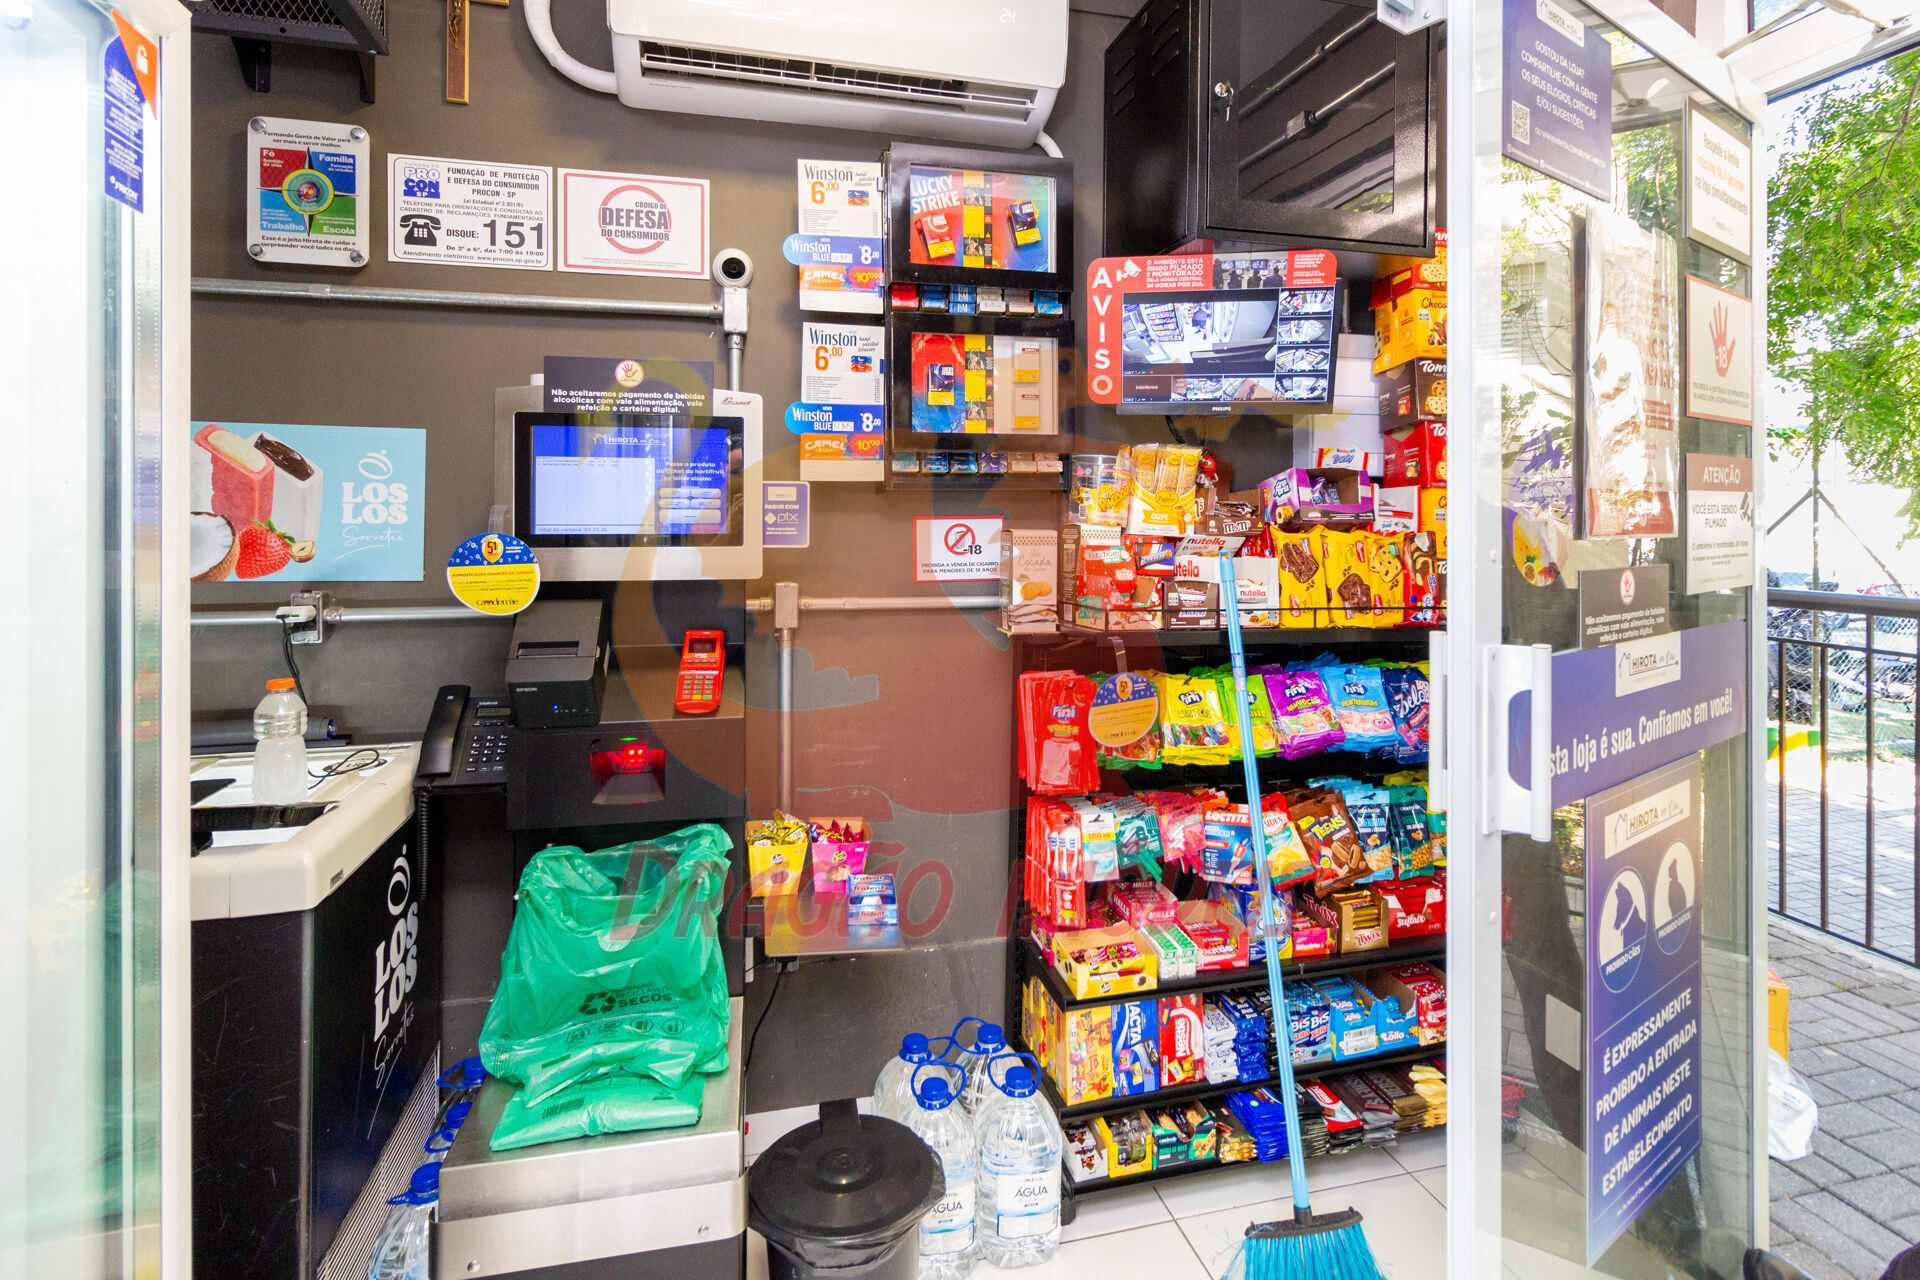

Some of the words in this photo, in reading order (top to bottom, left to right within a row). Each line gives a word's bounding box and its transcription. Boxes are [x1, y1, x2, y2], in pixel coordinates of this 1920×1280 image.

[1000, 8, 1016, 23] 24
[1535, 40, 1560, 64] GOSTOU
[1568, 60, 1585, 78] LOJA?
[1521, 50, 1562, 83] COMPARTILHE
[1562, 74, 1575, 90] COM
[1522, 69, 1531, 83] OS
[1531, 74, 1547, 92] SEUS
[262, 149, 276, 157] Fé
[319, 154, 354, 164] Família
[404, 166, 440, 180] PRO
[447, 167, 486, 178] FUNDAÇÃO
[489, 170, 500, 178] DE
[503, 171, 540, 182] PROTEÇÃO
[804, 164, 853, 182] Winston
[404, 178, 440, 192] CON
[453, 177, 480, 186] DEFESA
[494, 180, 540, 190] CONSUMIDOR
[910, 174, 953, 197] LUCKY
[472, 188, 500, 198] PROCON
[506, 190, 516, 198] SP
[403, 200, 434, 208] TELEFONE
[452, 204, 494, 212] ORIENTAÇÕES
[500, 206, 534, 215] CONSULTAS
[635, 201, 658, 210] CÓDIGO
[912, 191, 960, 214] STRIKE
[400, 206, 433, 214] CADASTRO
[446, 209, 491, 218] RECLAMAÇÕES
[494, 213, 544, 222] FUNDAMENTADAS
[602, 207, 669, 230] DEFESA
[262, 222, 304, 231] Trabalho
[323, 226, 354, 235] Escola
[446, 228, 480, 239] DISQUE:
[483, 219, 544, 250] 151
[601, 228, 612, 238] DO
[614, 229, 670, 241] CONSUMIDOR
[790, 238, 831, 253] Winston
[403, 250, 442, 258] Atendimento
[812, 252, 831, 262] BLUE
[1146, 264, 1168, 272] SENDO
[804, 270, 846, 282] CAMEL
[809, 327, 857, 347] Winston
[1092, 266, 1113, 396] AVISO
[554, 396, 597, 404] alcoólicas
[634, 398, 685, 408] alimentação,
[569, 390, 617, 398] aceitaremos
[618, 392, 662, 400] pagamento
[675, 392, 705, 400] bebidas
[577, 404, 610, 412] refeição
[792, 406, 832, 422] Winston
[814, 421, 832, 431] BLUE
[608, 436, 638, 444] HIROTA
[804, 440, 846, 450] CAMEL
[690, 461, 716, 469] produto
[1703, 464, 1741, 487] ATENÇÃO
[342, 482, 408, 504] LOS
[342, 503, 408, 524] LOS
[1692, 502, 1707, 515] VOCÊ
[1720, 504, 1738, 514] SENDO
[778, 512, 799, 524] pix
[962, 544, 982, 555] -18
[1187, 538, 1226, 546] nutella
[1018, 555, 1052, 568] Cocada
[1240, 590, 1267, 598] nutella
[1632, 654, 1658, 670] HIROTA
[1573, 735, 1597, 774] loja
[1600, 728, 1608, 759] é
[1611, 727, 1636, 756] sua.
[1639, 706, 1692, 745] Confiamos
[1694, 702, 1708, 724] em
[1710, 688, 1733, 719] você!
[1630, 807, 1659, 832] HIROTA
[1088, 832, 1102, 840] 100
[1311, 816, 1347, 841] TEENS
[852, 874, 884, 882] Trident
[1114, 894, 1130, 918] HALLS
[860, 910, 886, 918] Trident
[1149, 908, 1176, 920] HALLS
[375, 901, 418, 994] LOS
[1605, 953, 1628, 976] PROIBIDO
[1627, 944, 1642, 963] CÃES
[374, 944, 418, 1042] LOS
[618, 993, 672, 1008] SECOS
[1128, 1002, 1144, 1046] LACTA
[1604, 1046, 1611, 1075] É
[1612, 988, 1692, 1068] EXPRESSAMENTE
[1596, 1062, 1646, 1122] PROIBIDO
[1646, 1056, 1655, 1077] A
[1654, 1019, 1698, 1070] ENTRADA
[1604, 1124, 1620, 1155] DE
[1620, 1086, 1663, 1137] ANIMAIS
[1662, 1058, 1692, 1096] NESTE
[1602, 1093, 1694, 1198] ESTABELECIMENTO
[1014, 1186, 1048, 1198] ÁGUA
